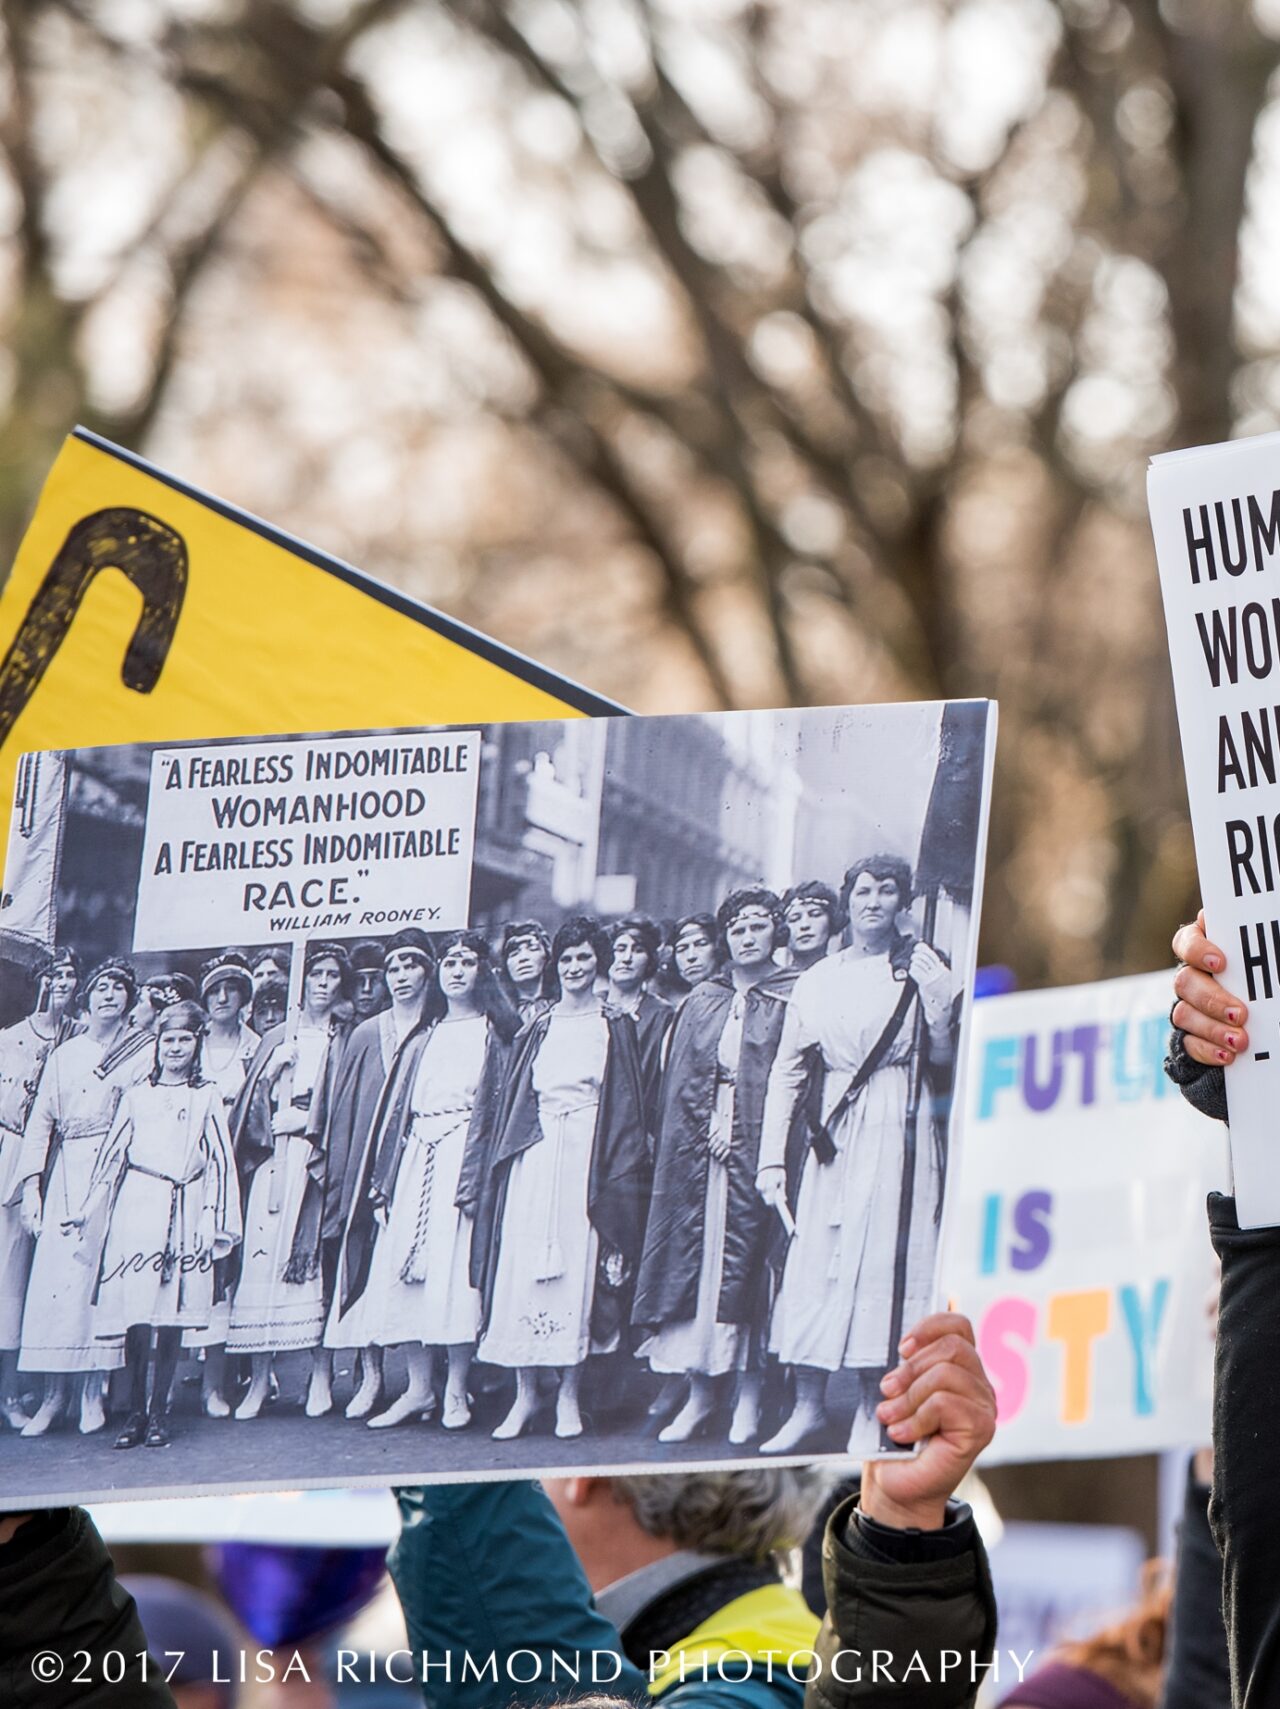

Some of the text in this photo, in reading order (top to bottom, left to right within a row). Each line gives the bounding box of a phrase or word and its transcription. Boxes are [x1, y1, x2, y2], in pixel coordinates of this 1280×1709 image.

[161, 744, 468, 791] “A FEARLESS INDOMITABLE
[211, 788, 426, 829] WOMANHOOD
[154, 828, 460, 876] A FEARLESS INDOMITABLE
[243, 868, 370, 912] RACE.”
[269, 906, 442, 932] WILLIAM ROONEY.
[979, 1189, 1054, 1276] IS
[952, 1279, 1169, 1425] STY
